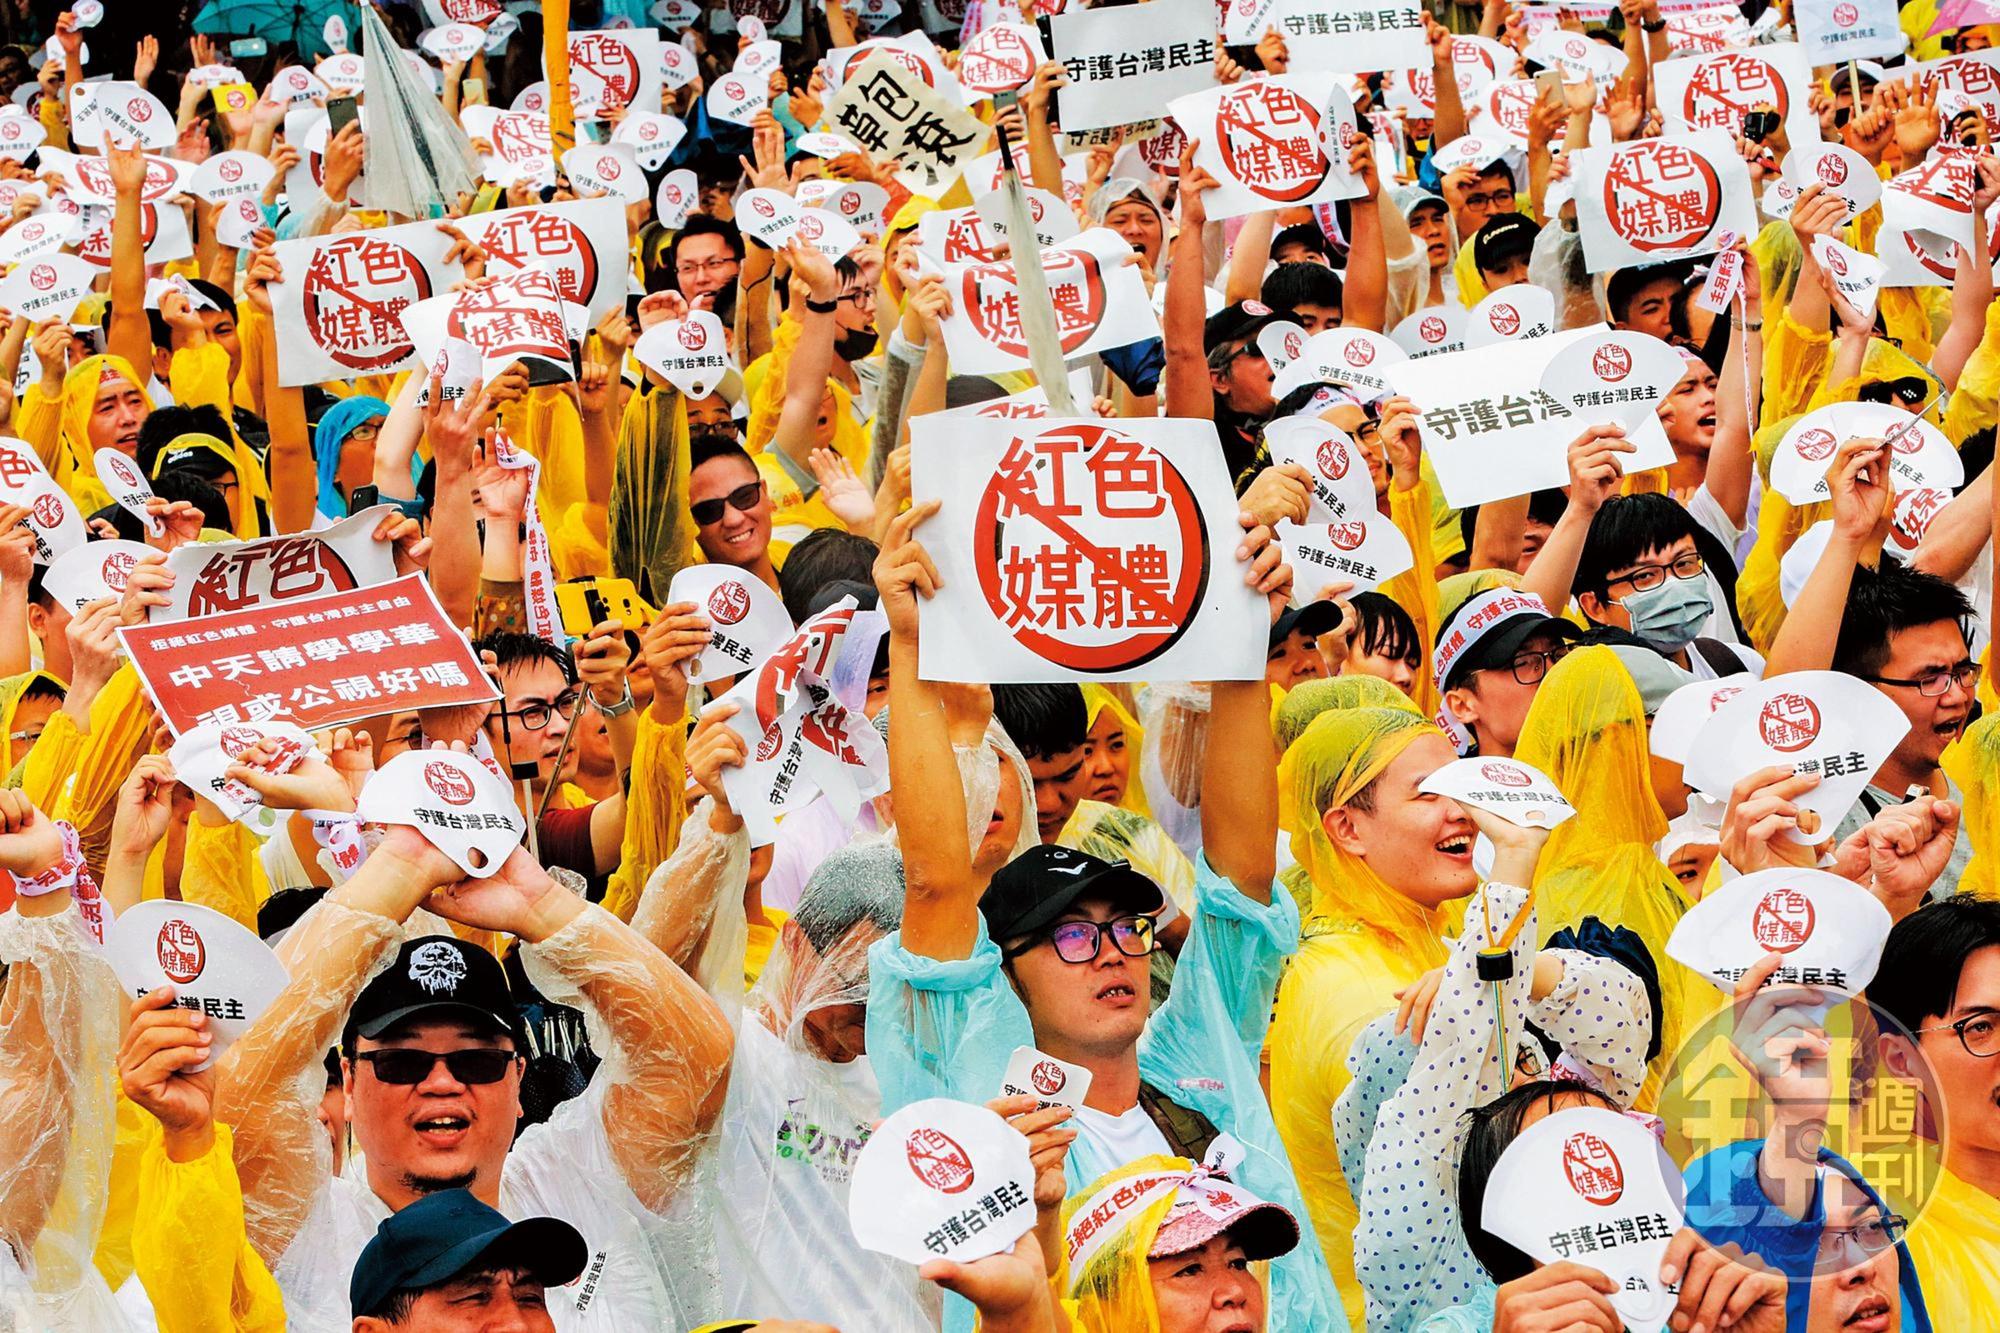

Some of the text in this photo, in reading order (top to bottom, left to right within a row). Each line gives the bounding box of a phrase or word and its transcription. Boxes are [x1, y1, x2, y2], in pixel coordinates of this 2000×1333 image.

[1284, 8, 1422, 36] 守護台灣民主
[569, 33, 625, 65] 紅色
[1063, 39, 1214, 82] 守護台灣民主
[1693, 57, 1768, 99] 紅色
[104, 106, 151, 146] 守護台灣民主
[1218, 83, 1302, 133] 紅色
[1234, 136, 1323, 184] 媒體
[1610, 146, 1696, 193] 紅色
[1621, 190, 1712, 240] 媒體
[477, 215, 575, 264] 紅色
[309, 240, 408, 292] 紅色
[21, 288, 80, 313] 守護台灣民主
[455, 268, 560, 316] 紅色
[469, 308, 571, 360] 媒體
[662, 353, 725, 372] 守護台灣民主
[1317, 364, 1386, 391] 守護台灣民主
[1422, 387, 1574, 442] 守護台灣
[1572, 384, 1659, 409] 守護台灣民主
[996, 435, 1168, 519] 紅色
[198, 537, 326, 614] 紅色
[1297, 544, 1378, 582] 守護台灣民主
[1004, 543, 1179, 631] 媒體
[169, 621, 440, 692] 中天請學學華
[1762, 693, 1808, 721] 紅色
[1767, 718, 1814, 748] 媒體
[426, 761, 462, 781] 紅色
[433, 781, 471, 803] 媒體
[413, 807, 516, 834] 守護台灣民主
[1759, 890, 1807, 915] 紅色
[162, 919, 197, 946] 紅色
[1758, 920, 1807, 945] 媒體
[161, 948, 198, 975] 媒體
[907, 1127, 946, 1162] 紅色
[1563, 1133, 1606, 1163] 紅色
[925, 1154, 975, 1194] 媒體
[1573, 1164, 1622, 1197] 媒體
[922, 1180, 1029, 1256] 守護台灣民主
[1548, 1212, 1673, 1258] 守護台灣民主
